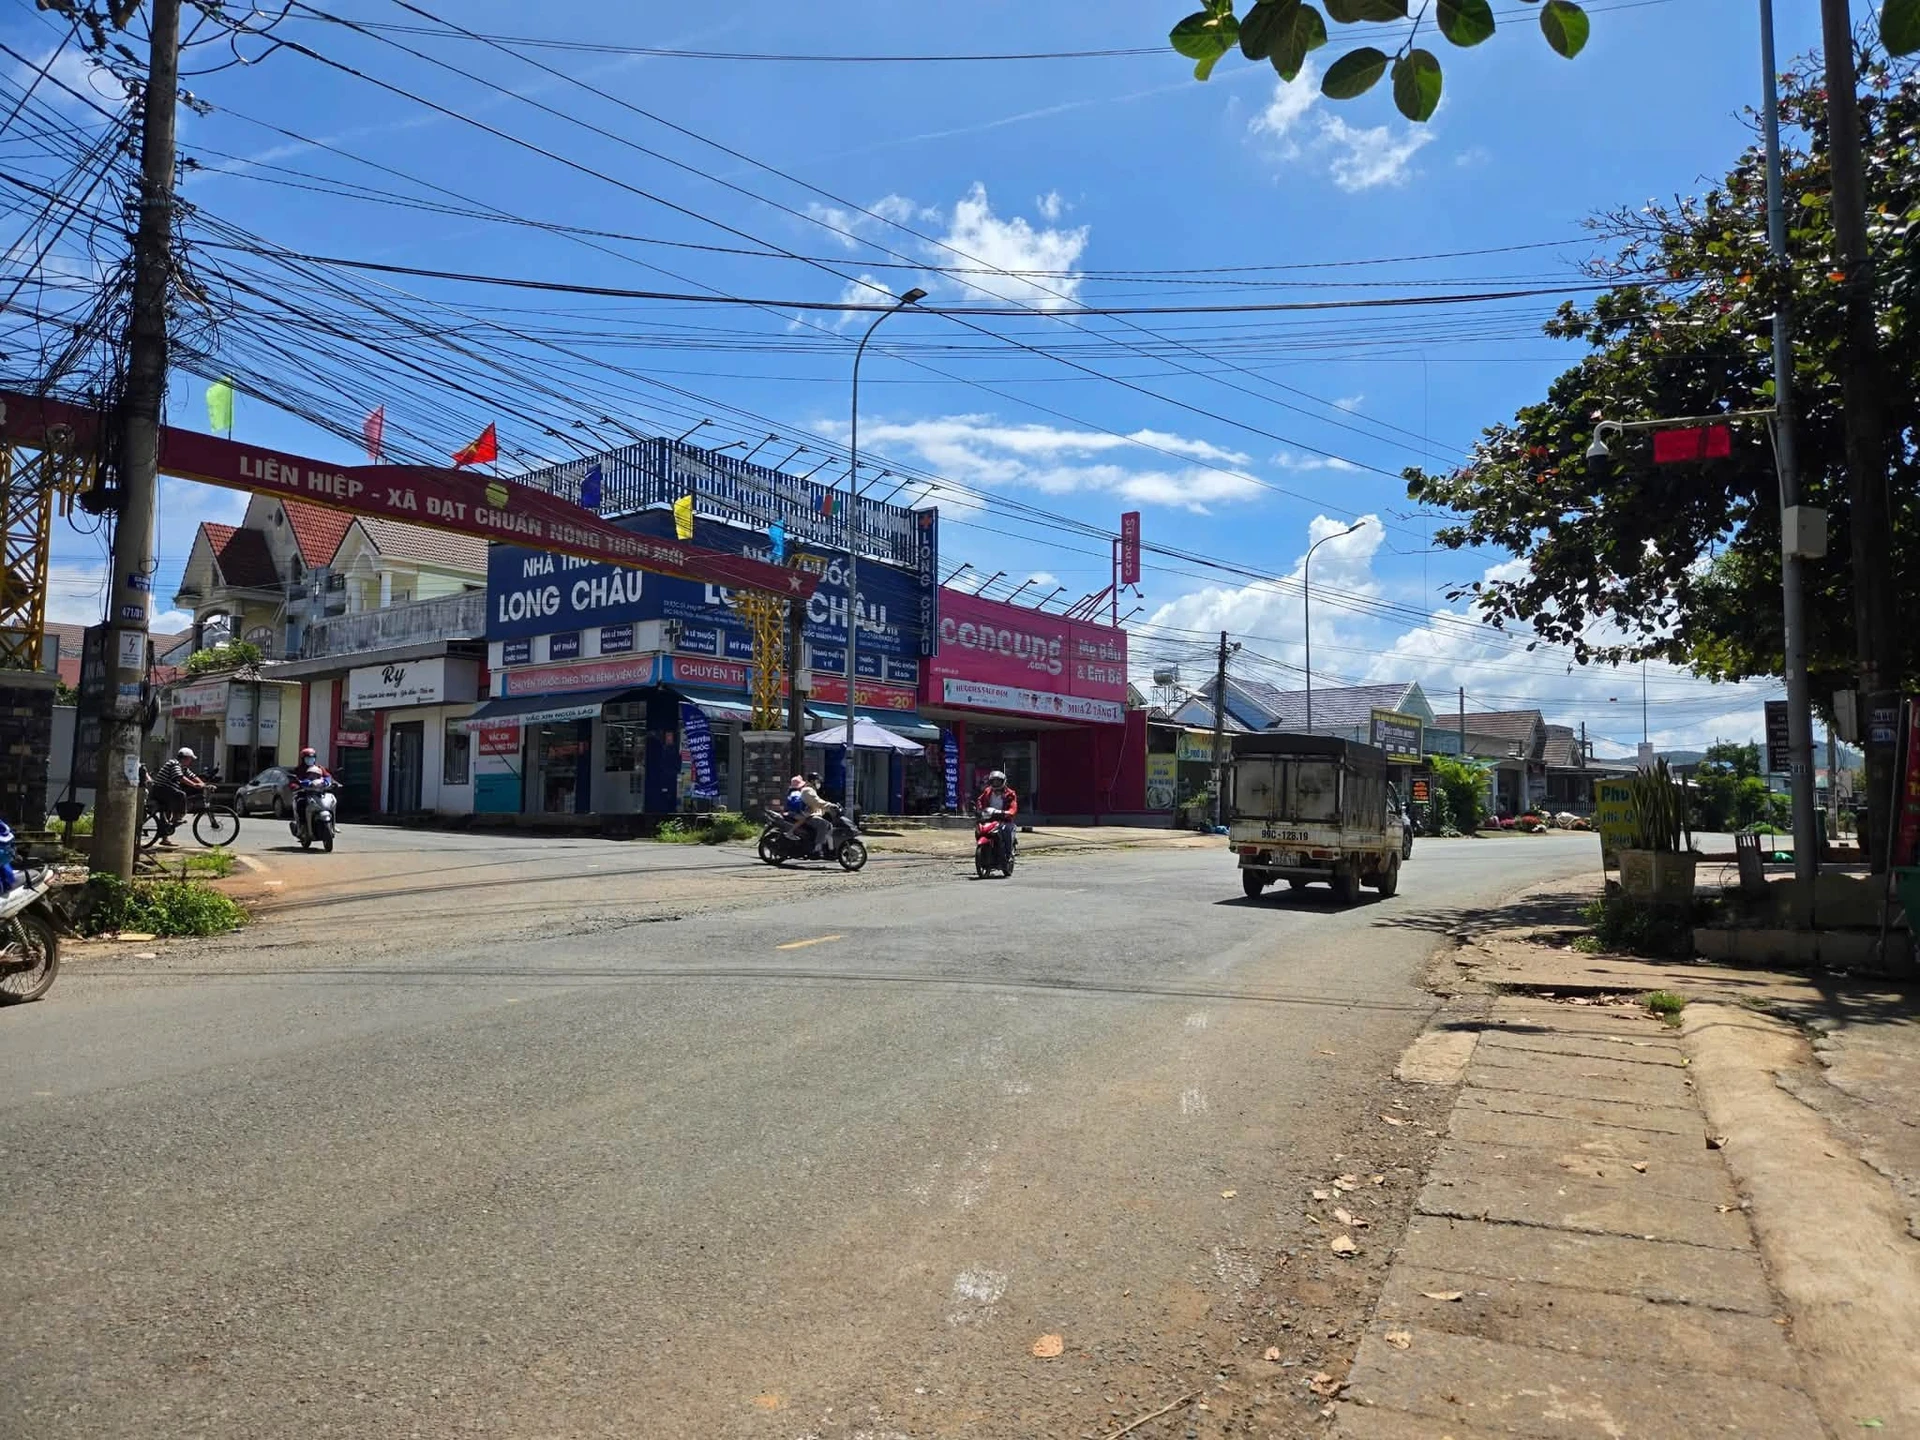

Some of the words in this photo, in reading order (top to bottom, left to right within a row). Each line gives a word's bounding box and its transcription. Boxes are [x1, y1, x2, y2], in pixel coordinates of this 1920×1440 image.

[239, 456, 299, 486] LIÊN
[307, 470, 363, 499] HIỆP
[387, 488, 418, 511] XÃ
[426, 497, 466, 522] ĐẠT
[523, 551, 554, 578] NHÀ
[920, 532, 931, 587] LONG
[499, 585, 560, 622] LONG
[571, 567, 643, 611] CHÂU
[806, 592, 886, 633] CHÂU
[920, 597, 931, 655] CHÂU
[940, 618, 1064, 675] concung
[382, 665, 406, 688] Ry
[680, 663, 728, 680] CHUYÊN
[1087, 665, 1106, 683] Em
[1107, 668, 1122, 685] Bé
[1085, 702, 1092, 714] 2
